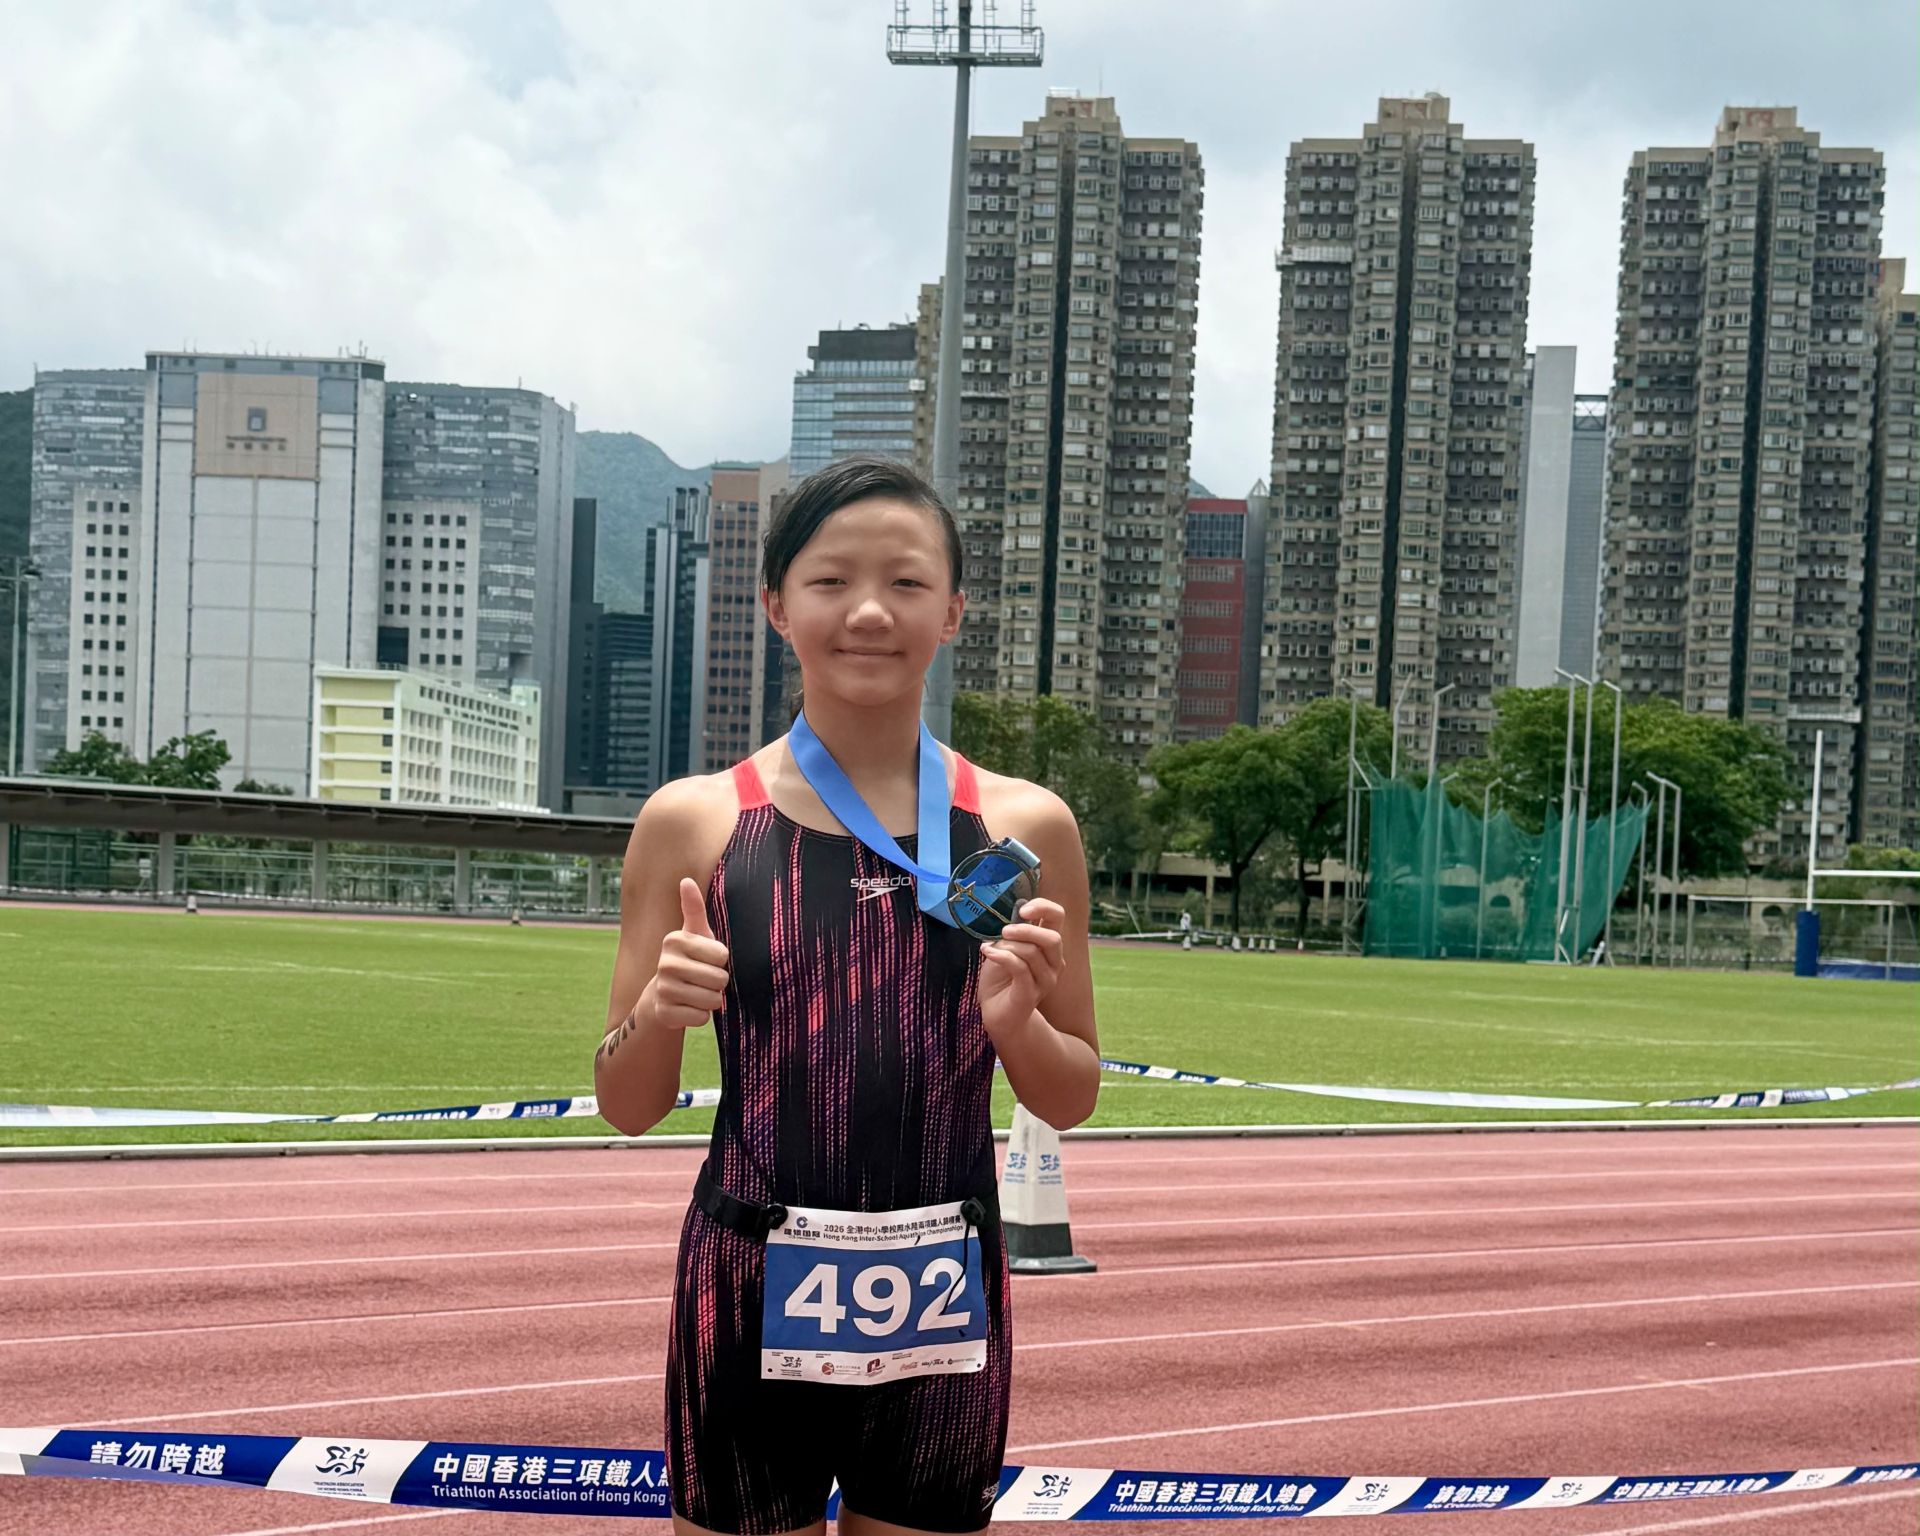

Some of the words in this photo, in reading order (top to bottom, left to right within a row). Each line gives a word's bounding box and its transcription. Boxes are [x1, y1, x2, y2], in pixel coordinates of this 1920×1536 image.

[850, 874, 911, 888] speedo
[824, 1224, 845, 1233] 2026
[823, 1233, 840, 1242] Hong
[841, 1234, 858, 1243] Kong
[859, 1233, 898, 1242] Inter-School
[784, 1257, 971, 1337] 492
[89, 1440, 226, 1476] 請勿跨越
[431, 1484, 496, 1499] Triathlon
[498, 1486, 577, 1502] Association
[580, 1488, 595, 1502] of
[596, 1489, 631, 1505] Hong
[633, 1490, 667, 1506] Kong
[1115, 1479, 1318, 1504] 中國香港三項鐵人總會
[1108, 1503, 1153, 1513] Triathlon
[1154, 1503, 1212, 1513] Association
[1212, 1503, 1225, 1513] of
[1225, 1503, 1250, 1514] Hong
[1251, 1503, 1276, 1514] Kong
[1276, 1503, 1305, 1512] China
